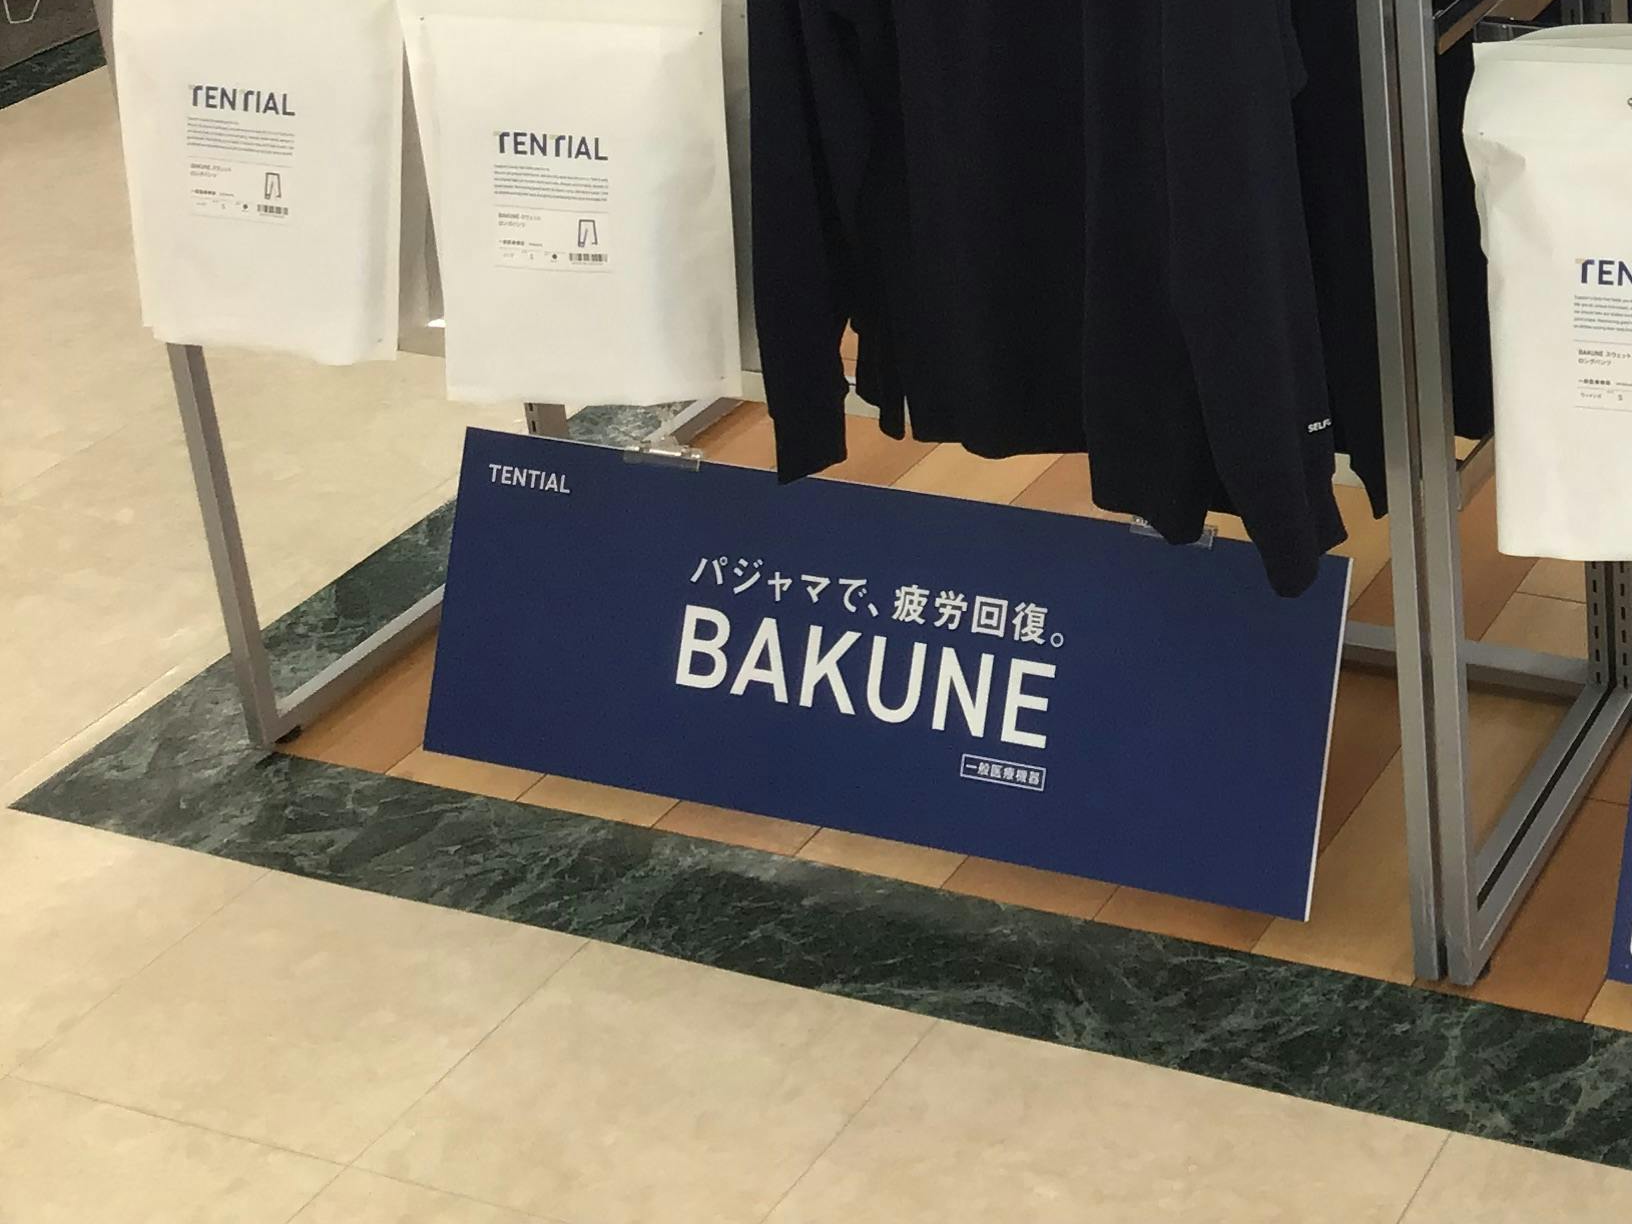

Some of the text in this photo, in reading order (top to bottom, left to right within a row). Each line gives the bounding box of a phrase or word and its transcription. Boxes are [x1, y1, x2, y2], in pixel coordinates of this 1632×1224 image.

[188, 84, 296, 116] TENTIAL
[493, 131, 609, 161] TENTIAL
[488, 462, 571, 495] TENTIAL
[690, 554, 1065, 649] パジャマで、疲労回復。
[675, 604, 1057, 750] BAKUNE
